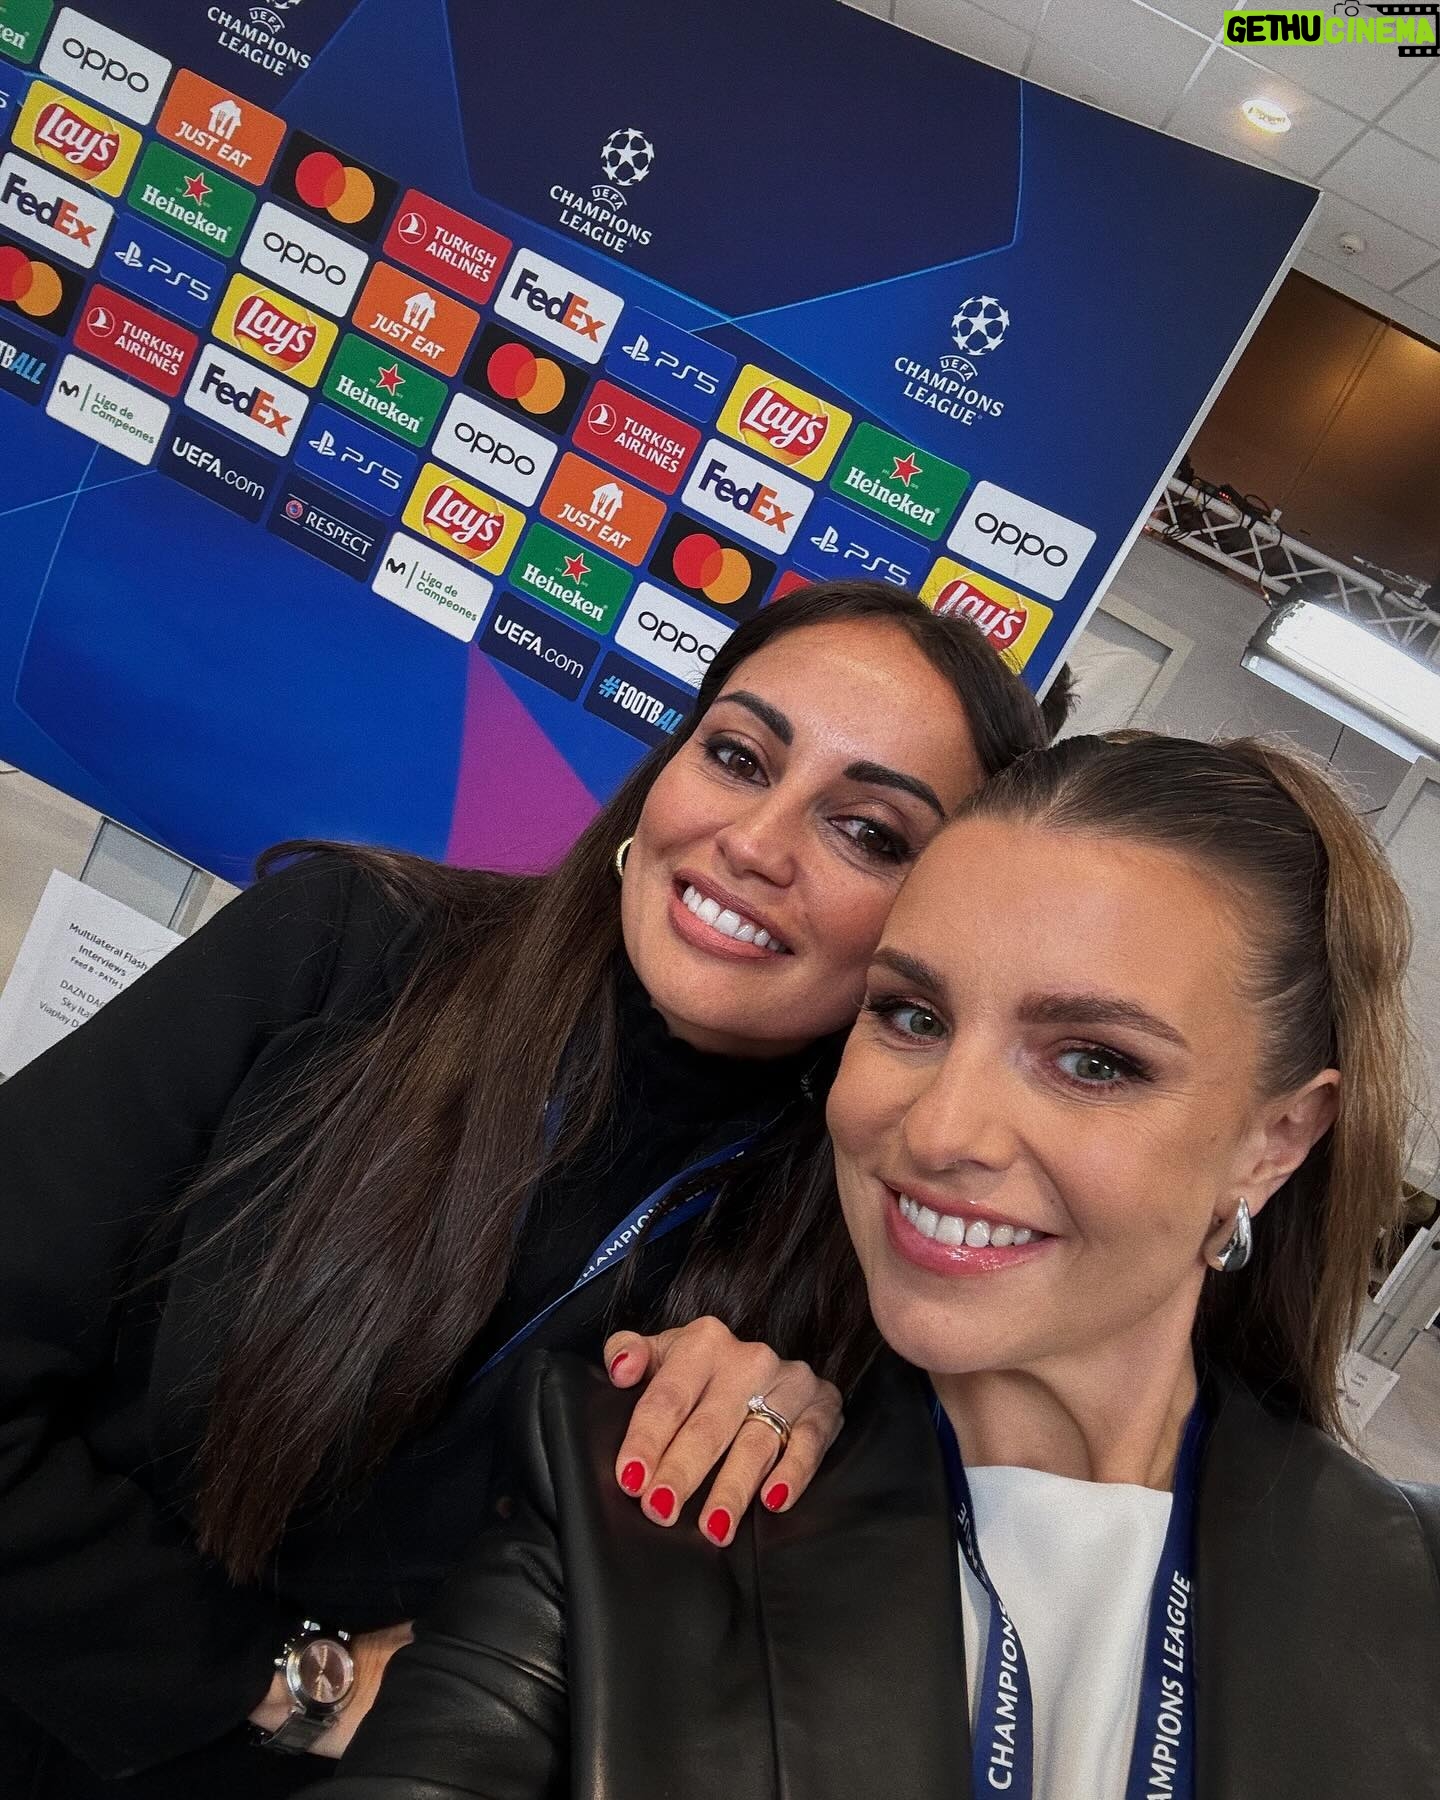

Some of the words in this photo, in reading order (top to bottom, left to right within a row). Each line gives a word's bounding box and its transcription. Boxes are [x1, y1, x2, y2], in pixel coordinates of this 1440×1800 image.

[207, 6, 312, 69] CHAMPIONS
[249, 10, 282, 33] UEFA
[62, 37, 149, 94] oppo
[217, 31, 288, 76] LEAGUE
[40, 106, 117, 164] Lay's
[175, 121, 220, 152] JUST
[219, 142, 252, 169] EAT
[1, 173, 97, 248] FedEx
[140, 184, 229, 243] Heineken
[549, 184, 653, 246] CHAMPIONS
[592, 188, 625, 211] UEFA
[434, 226, 498, 268] TURKISH
[559, 209, 628, 254] LEAGUE
[148, 260, 213, 302] PS5
[263, 232, 347, 286] oppo
[425, 242, 492, 283] AIRLINES
[238, 298, 313, 355] Lay's
[510, 268, 607, 344] FedEx
[114, 335, 180, 377] AIRLINES
[122, 320, 185, 363] TURKISH
[370, 313, 411, 343] JUST
[411, 335, 446, 360] EAT
[654, 351, 720, 395] PS5
[894, 356, 1005, 418] CHAMPIONS
[940, 358, 974, 381] UEFA
[94, 392, 118, 412] Liga
[119, 405, 134, 419] de
[199, 363, 293, 437] FedEx
[335, 374, 422, 434] Heineken
[743, 389, 824, 449] Lay's
[903, 381, 978, 426] LEAGUE
[90, 404, 155, 444] Campeones
[622, 416, 686, 459] TURKISH
[171, 436, 265, 501] UEFA.com
[340, 446, 402, 490] PS5
[454, 422, 535, 476] oppo
[614, 432, 680, 474] AIRLINES
[426, 487, 501, 544] Lay's
[698, 458, 795, 535] FedEx
[844, 466, 937, 526] Heineken
[305, 511, 373, 556] RESPECT
[557, 503, 600, 534] JUST
[598, 524, 632, 551] EAT
[974, 512, 1068, 568] oppo
[420, 569, 443, 590] Liga
[443, 584, 458, 597] de
[844, 542, 912, 587] PS5
[416, 580, 477, 622] Campeones
[521, 563, 605, 622] Heineken
[493, 614, 585, 680] UEFA.com
[638, 611, 718, 664] oppo
[599, 675, 684, 735] #FOOTBAL
[69, 922, 124, 957] Multilateral
[123, 951, 148, 972] Flash
[78, 944, 126, 977] Interviews
[59, 979, 87, 999] DAZN
[98, 971, 119, 987] PATH
[39, 1001, 71, 1025] Viaplay
[61, 997, 78, 1012] Sky
[1163, 1571, 1191, 1673] LEAGUE
